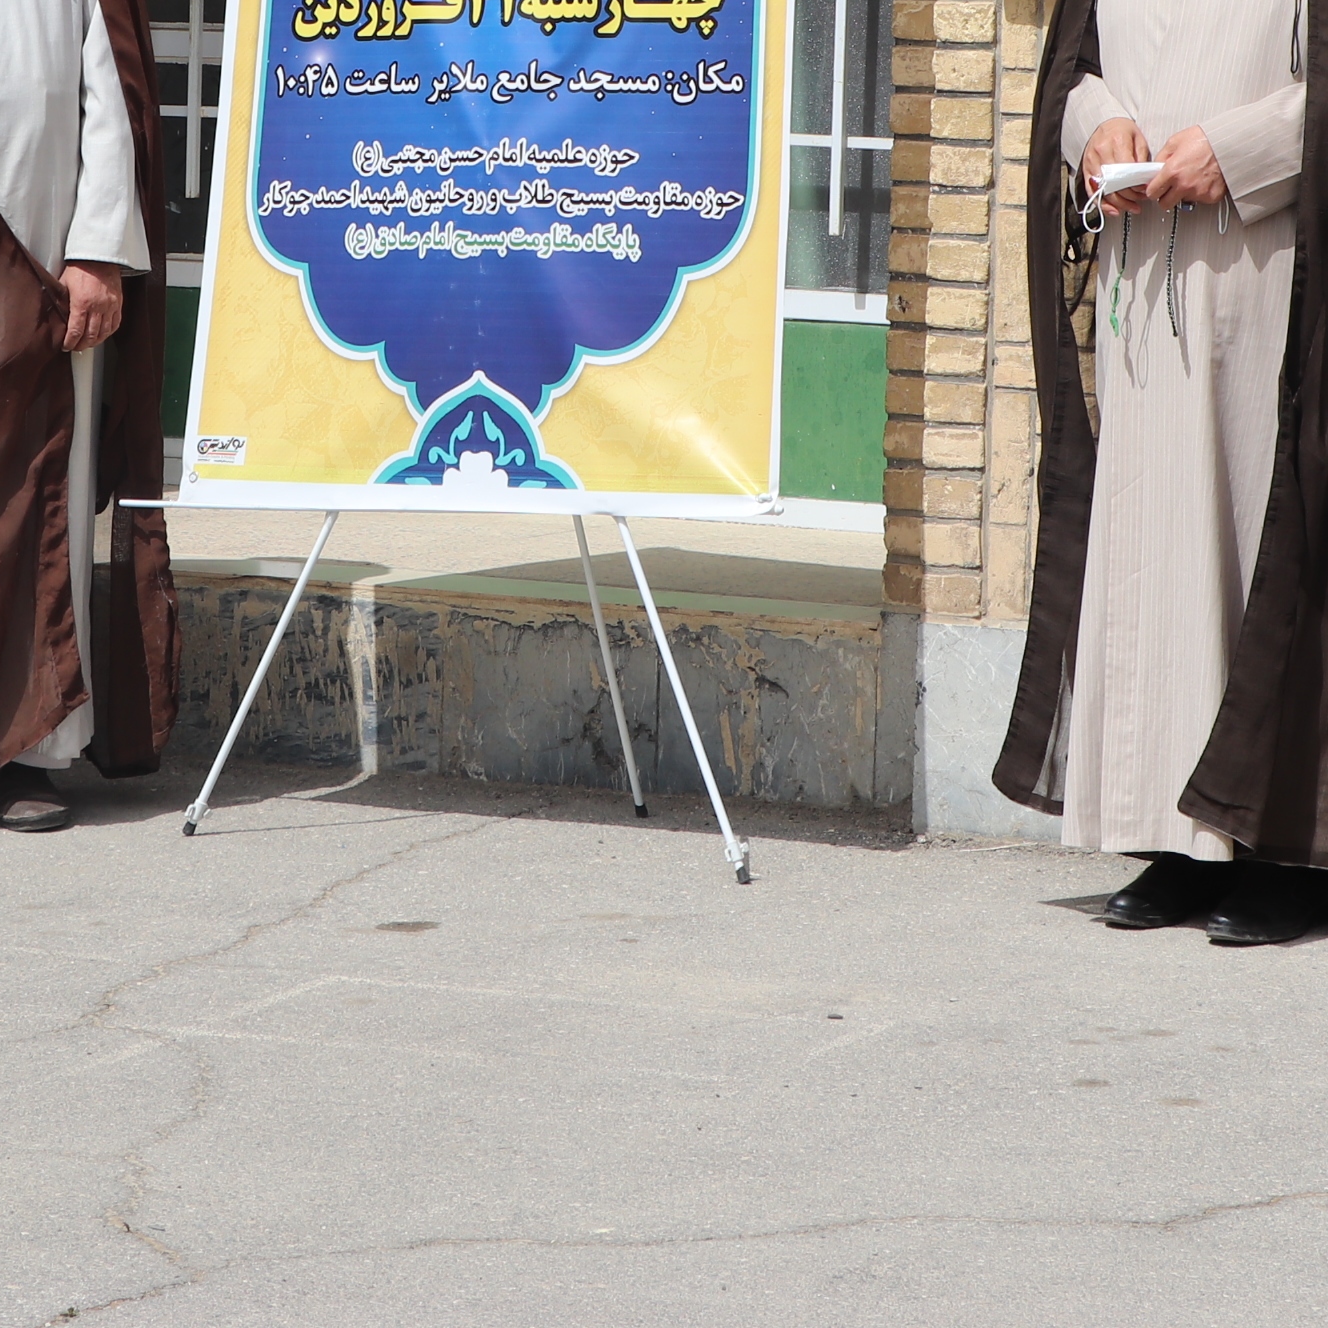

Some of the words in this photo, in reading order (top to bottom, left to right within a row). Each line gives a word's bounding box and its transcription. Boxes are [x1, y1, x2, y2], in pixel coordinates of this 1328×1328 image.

[344, 62, 420, 94] ساعت
[426, 60, 487, 105] ملایر
[490, 60, 564, 102] جامع
[568, 72, 660, 101] مسجد
[664, 60, 744, 105] مکان:
[439, 143, 485, 175] حسن
[486, 139, 527, 174] امام
[527, 139, 584, 170] علمیه
[586, 147, 638, 175] حوزه
[259, 180, 312, 216] جوکار
[314, 180, 360, 209] احمد
[359, 182, 408, 212] شهید
[408, 182, 487, 215] روحانیون
[487, 191, 501, 214] و
[501, 179, 556, 214] طلاب
[558, 187, 616, 216] بسیج
[619, 184, 691, 217] مقاومت
[691, 189, 744, 216] حوزه
[419, 220, 454, 259] امام
[452, 224, 507, 259] بسیج
[508, 223, 582, 260] مقاومت
[583, 224, 641, 262] پایگاه
